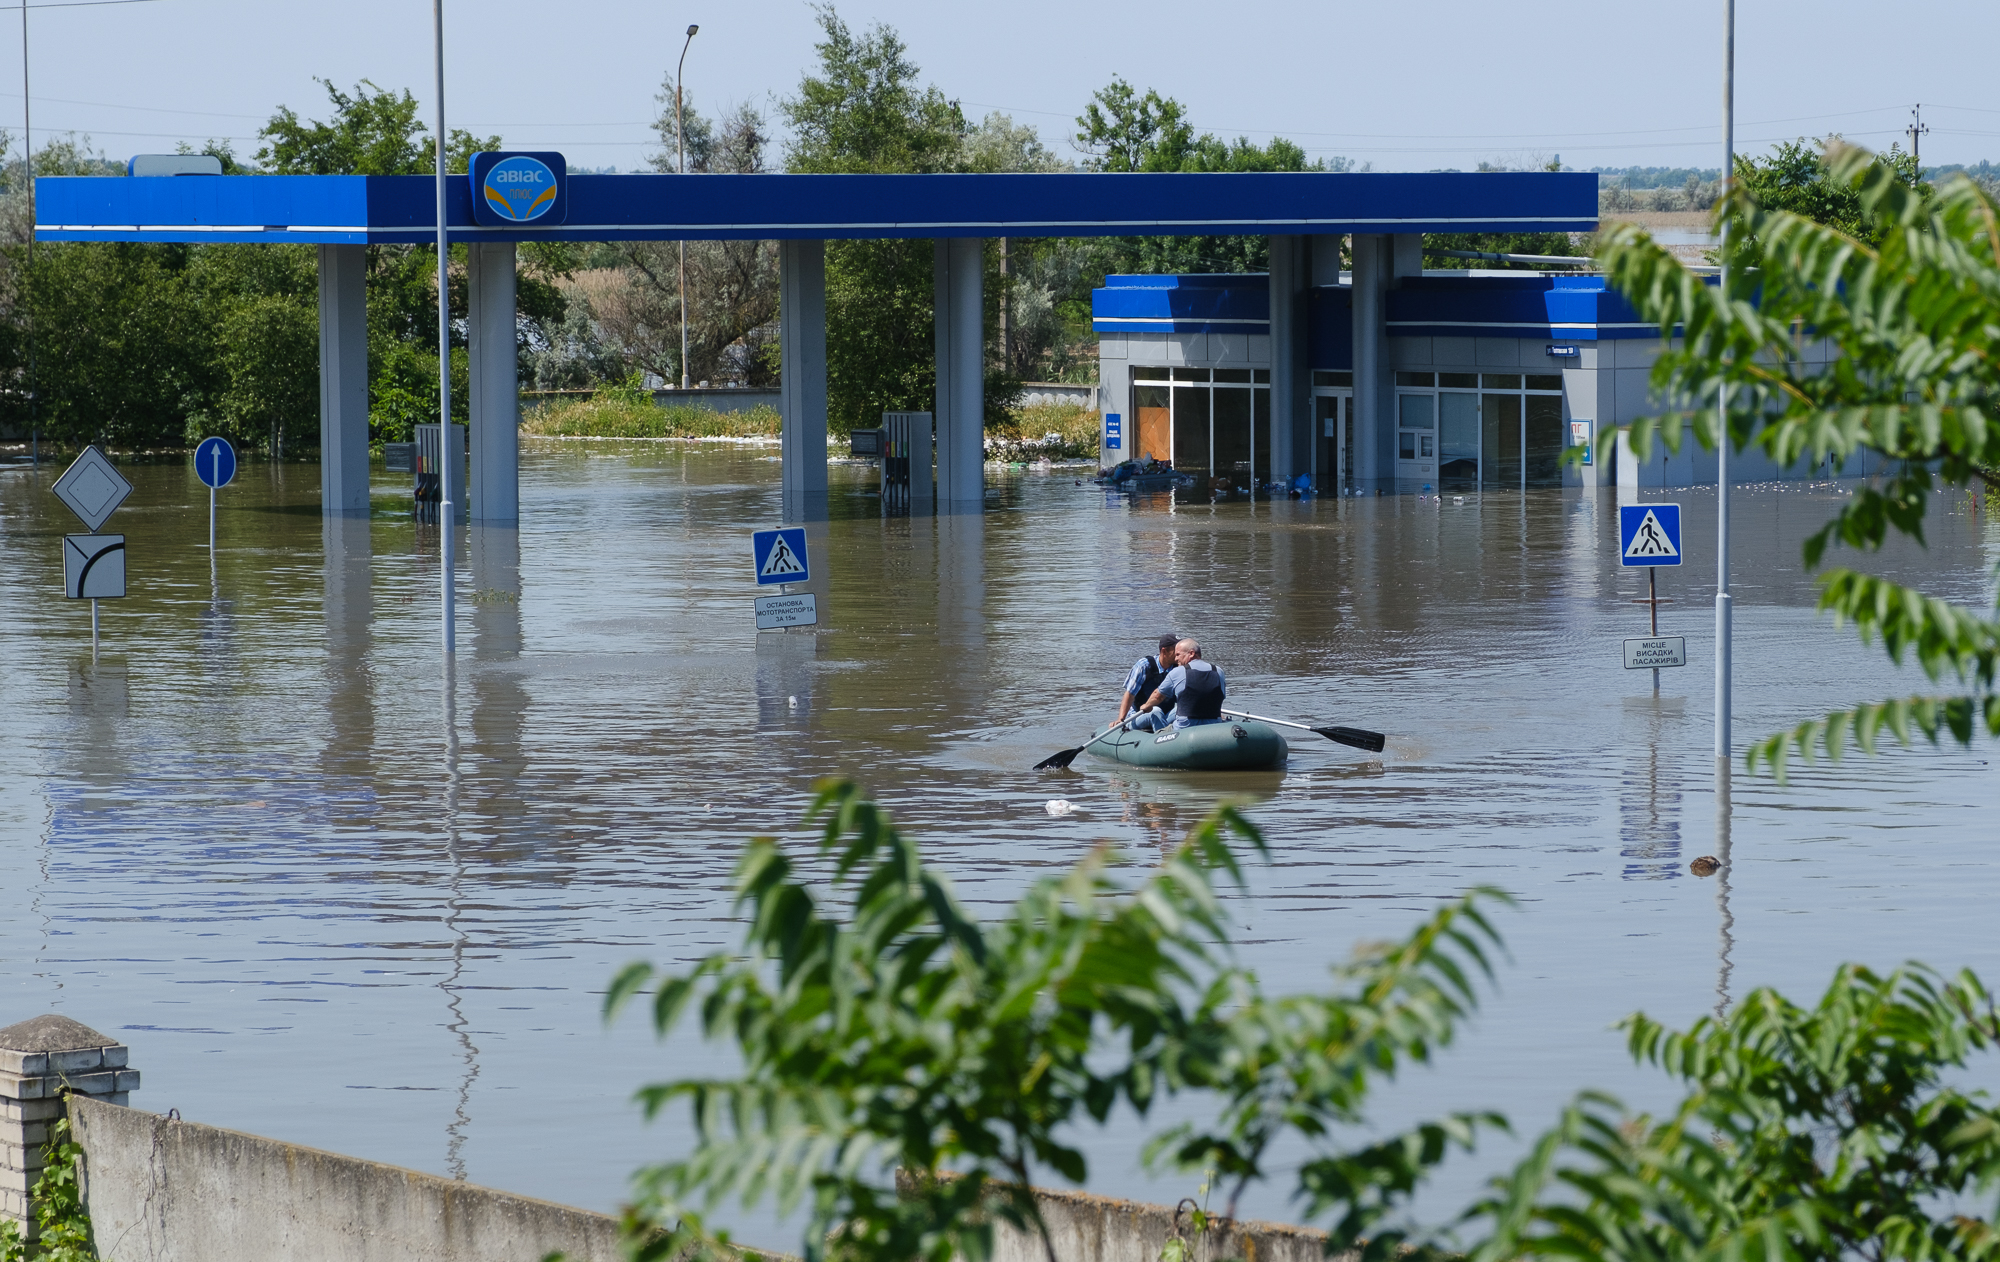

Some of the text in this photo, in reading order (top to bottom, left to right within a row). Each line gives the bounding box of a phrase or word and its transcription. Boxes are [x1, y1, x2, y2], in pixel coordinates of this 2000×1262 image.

[766, 600, 803, 609] ОСТАНОВКА
[756, 606, 815, 617] МОТОТРАНСПОРТА
[1642, 641, 1667, 649] МІСЦЕ
[1636, 649, 1674, 657] ВИСАДКИ
[1632, 656, 1679, 665] ПАСАЖИРІВ
[1156, 732, 1177, 743] BARK
